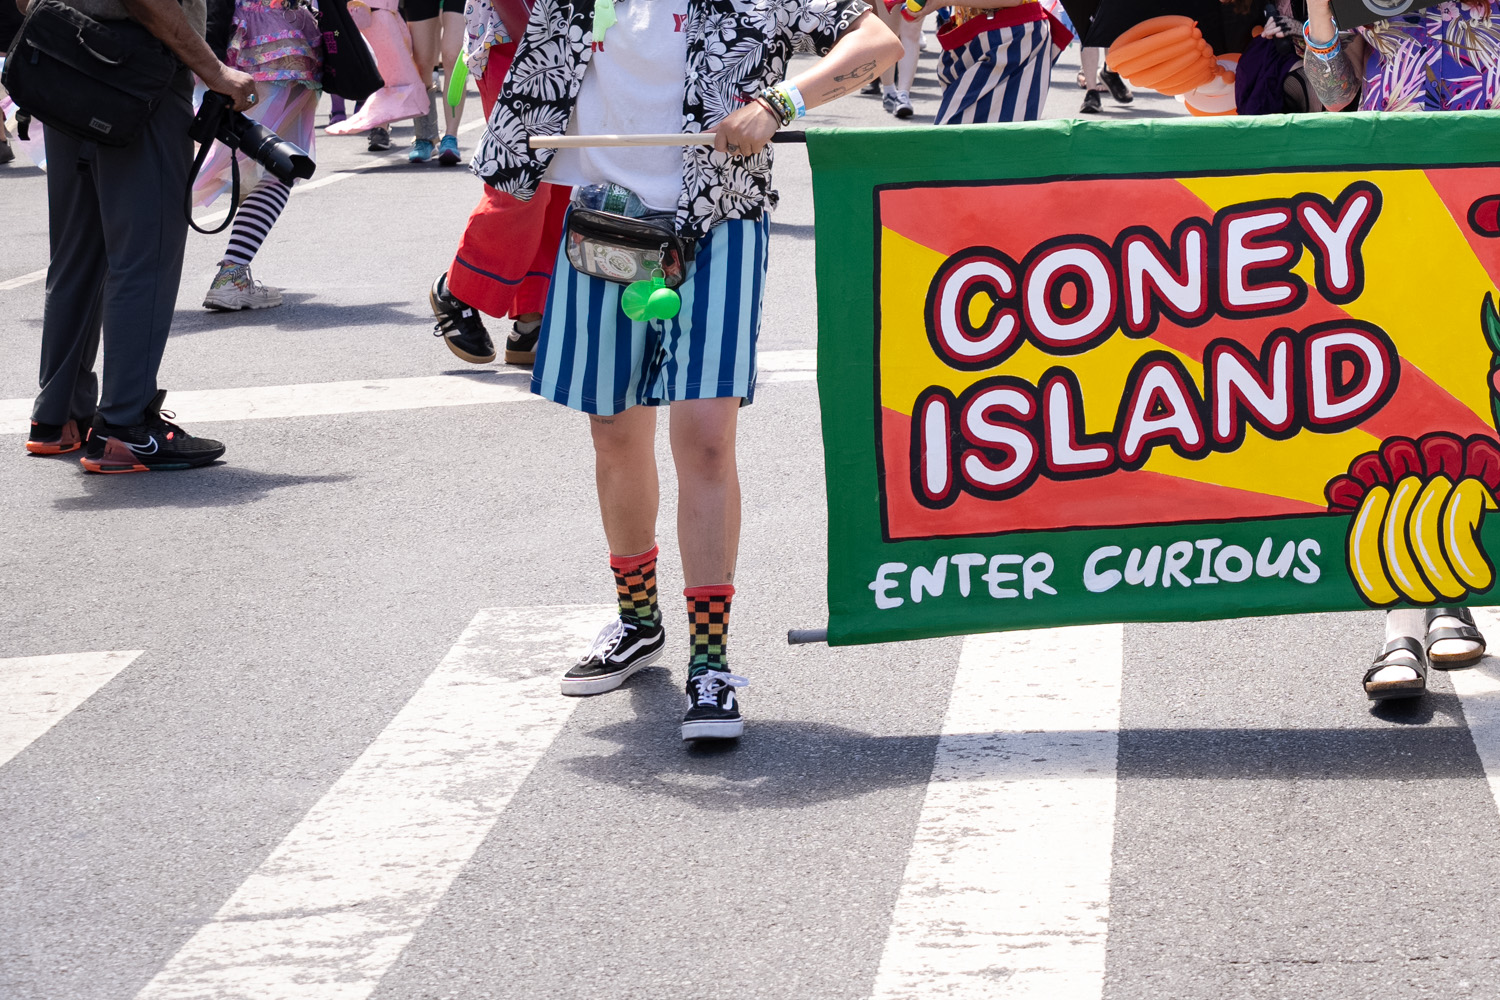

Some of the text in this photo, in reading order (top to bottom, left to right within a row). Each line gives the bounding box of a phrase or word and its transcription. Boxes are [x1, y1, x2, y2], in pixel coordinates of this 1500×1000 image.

[931, 187, 1376, 366] CONEY
[917, 325, 1393, 498] ISLAND
[869, 536, 1322, 609] ENTER CURIOUS
